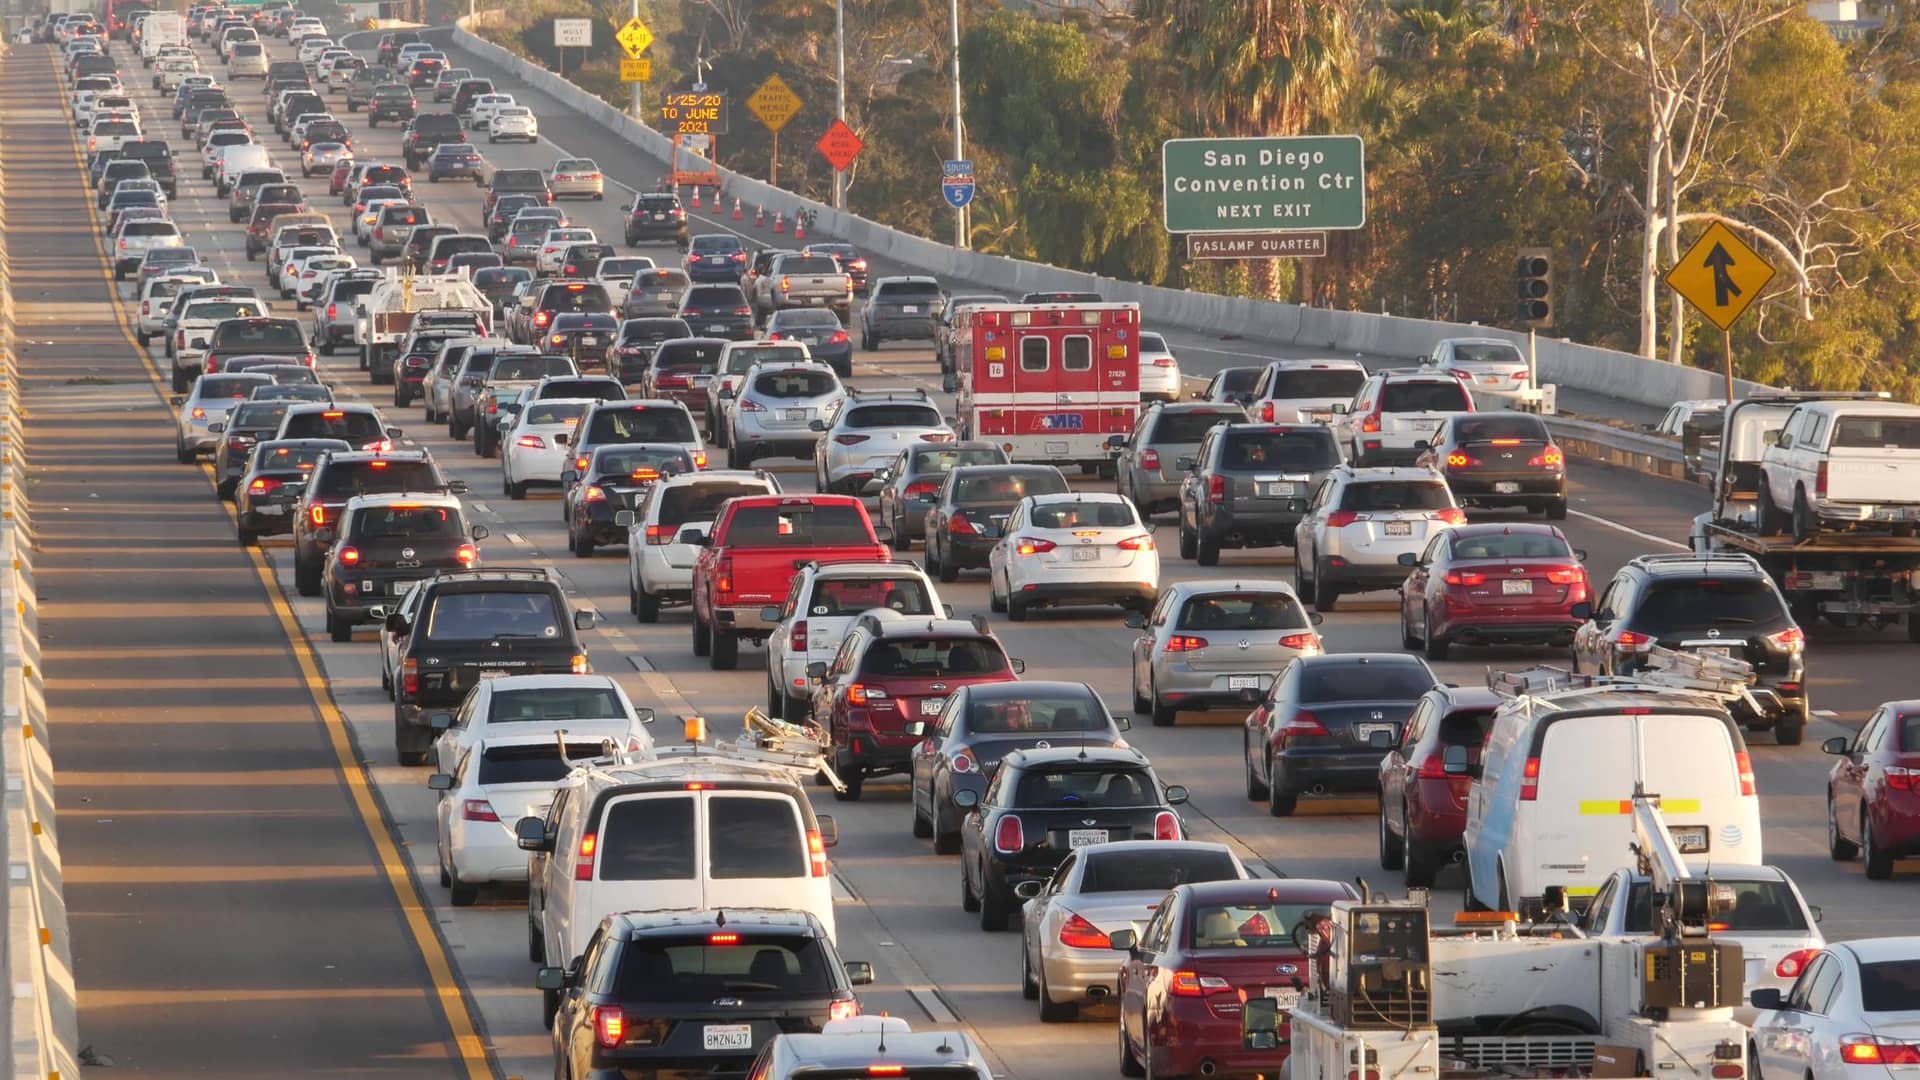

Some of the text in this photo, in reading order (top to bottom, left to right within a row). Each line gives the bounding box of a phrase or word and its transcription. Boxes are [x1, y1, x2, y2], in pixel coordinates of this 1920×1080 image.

[667, 95, 721, 106] 1/25/20
[661, 107, 719, 120] TO JUNE
[760, 104, 789, 112] MERGE
[764, 114, 785, 122] LEFT
[678, 121, 709, 133] 2021
[1204, 148, 1325, 171] San Diego
[946, 163, 971, 172] SOUTH
[1173, 173, 1355, 193] Convention Ctr
[954, 189, 964, 202] 5
[1217, 203, 1313, 219] NEXT EXIT
[1193, 239, 1321, 252] GASLAMP QUARTER
[991, 365, 1002, 376] 16
[1030, 413, 1083, 431] AMR
[706, 1033, 749, 1047] 8MZN437
